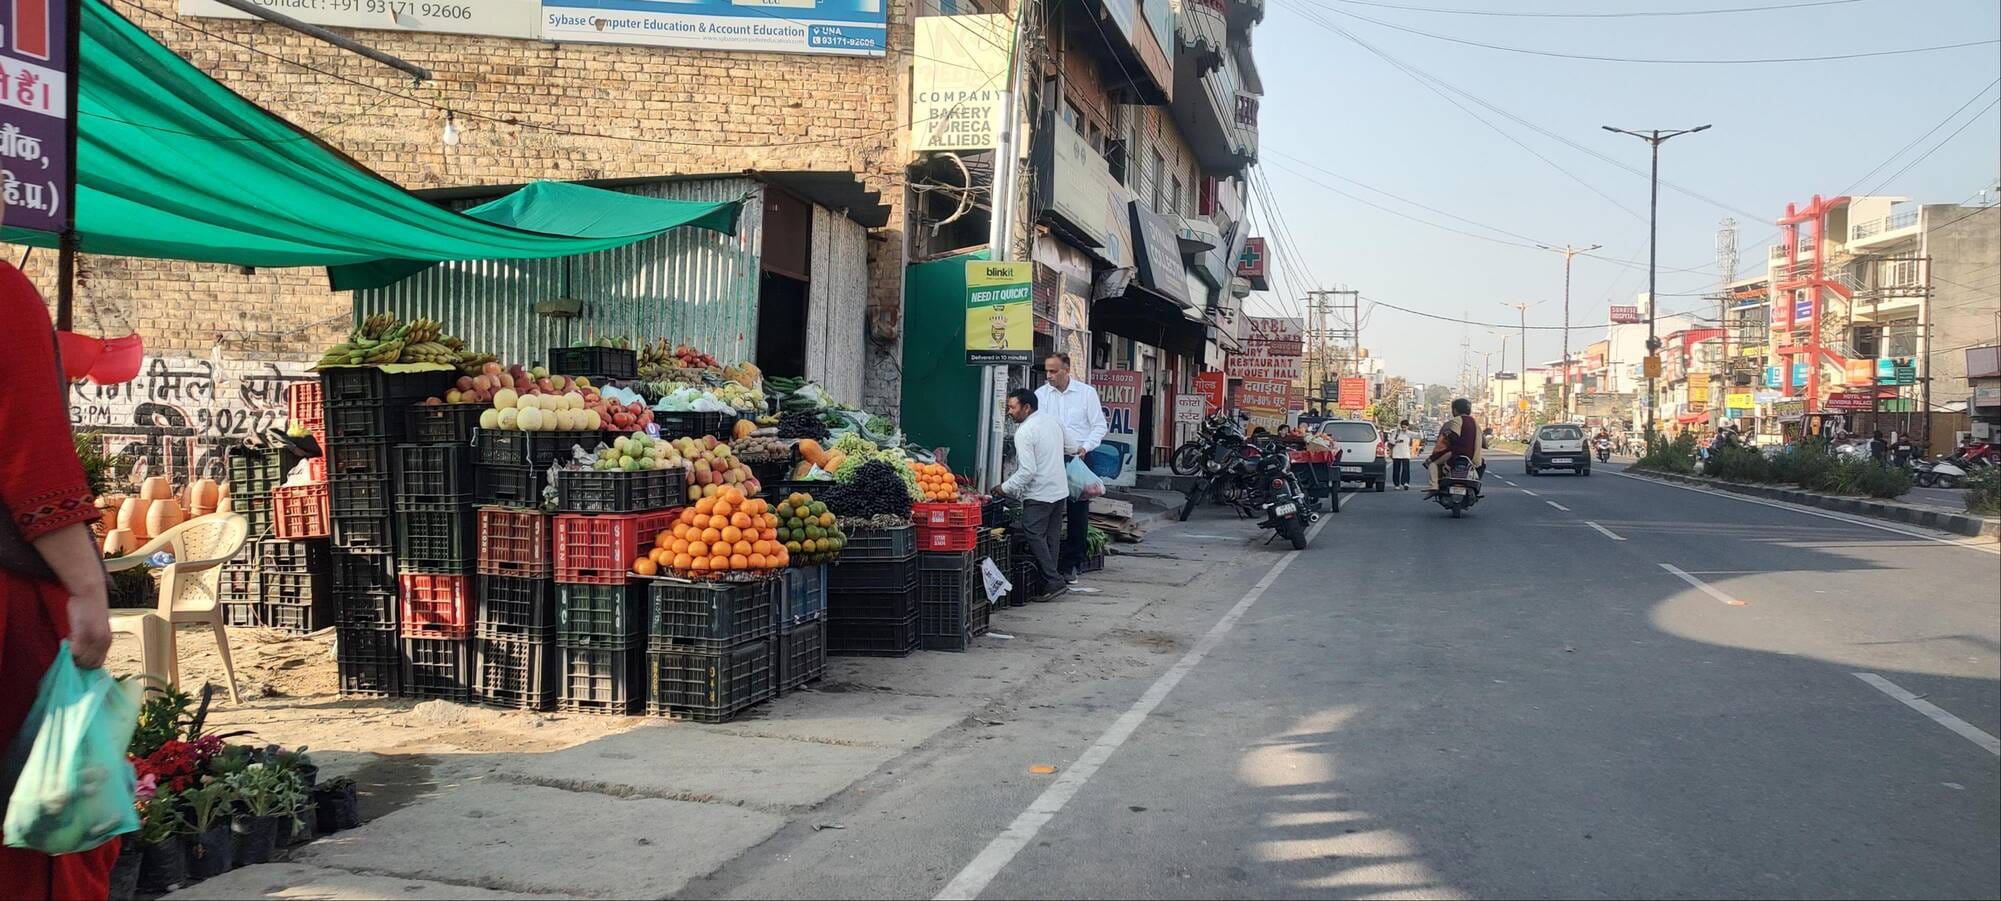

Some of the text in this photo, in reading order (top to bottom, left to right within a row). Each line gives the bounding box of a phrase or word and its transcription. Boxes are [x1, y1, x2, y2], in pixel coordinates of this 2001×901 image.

[421, 4, 472, 19] 92606
[549, 14, 805, 37] Sybase Cmputer Education & Account Education
[822, 27, 842, 36] UNA
[929, 106, 991, 120] BAKERY
[928, 133, 991, 147] ALLIEDS
[986, 267, 1013, 277] blinkit
[971, 287, 1028, 303] NEED IT QUICK?
[1230, 358, 1294, 368] RESTAURANT
[1274, 369, 1298, 379] HALL
[1095, 384, 1136, 404] HAKTI
